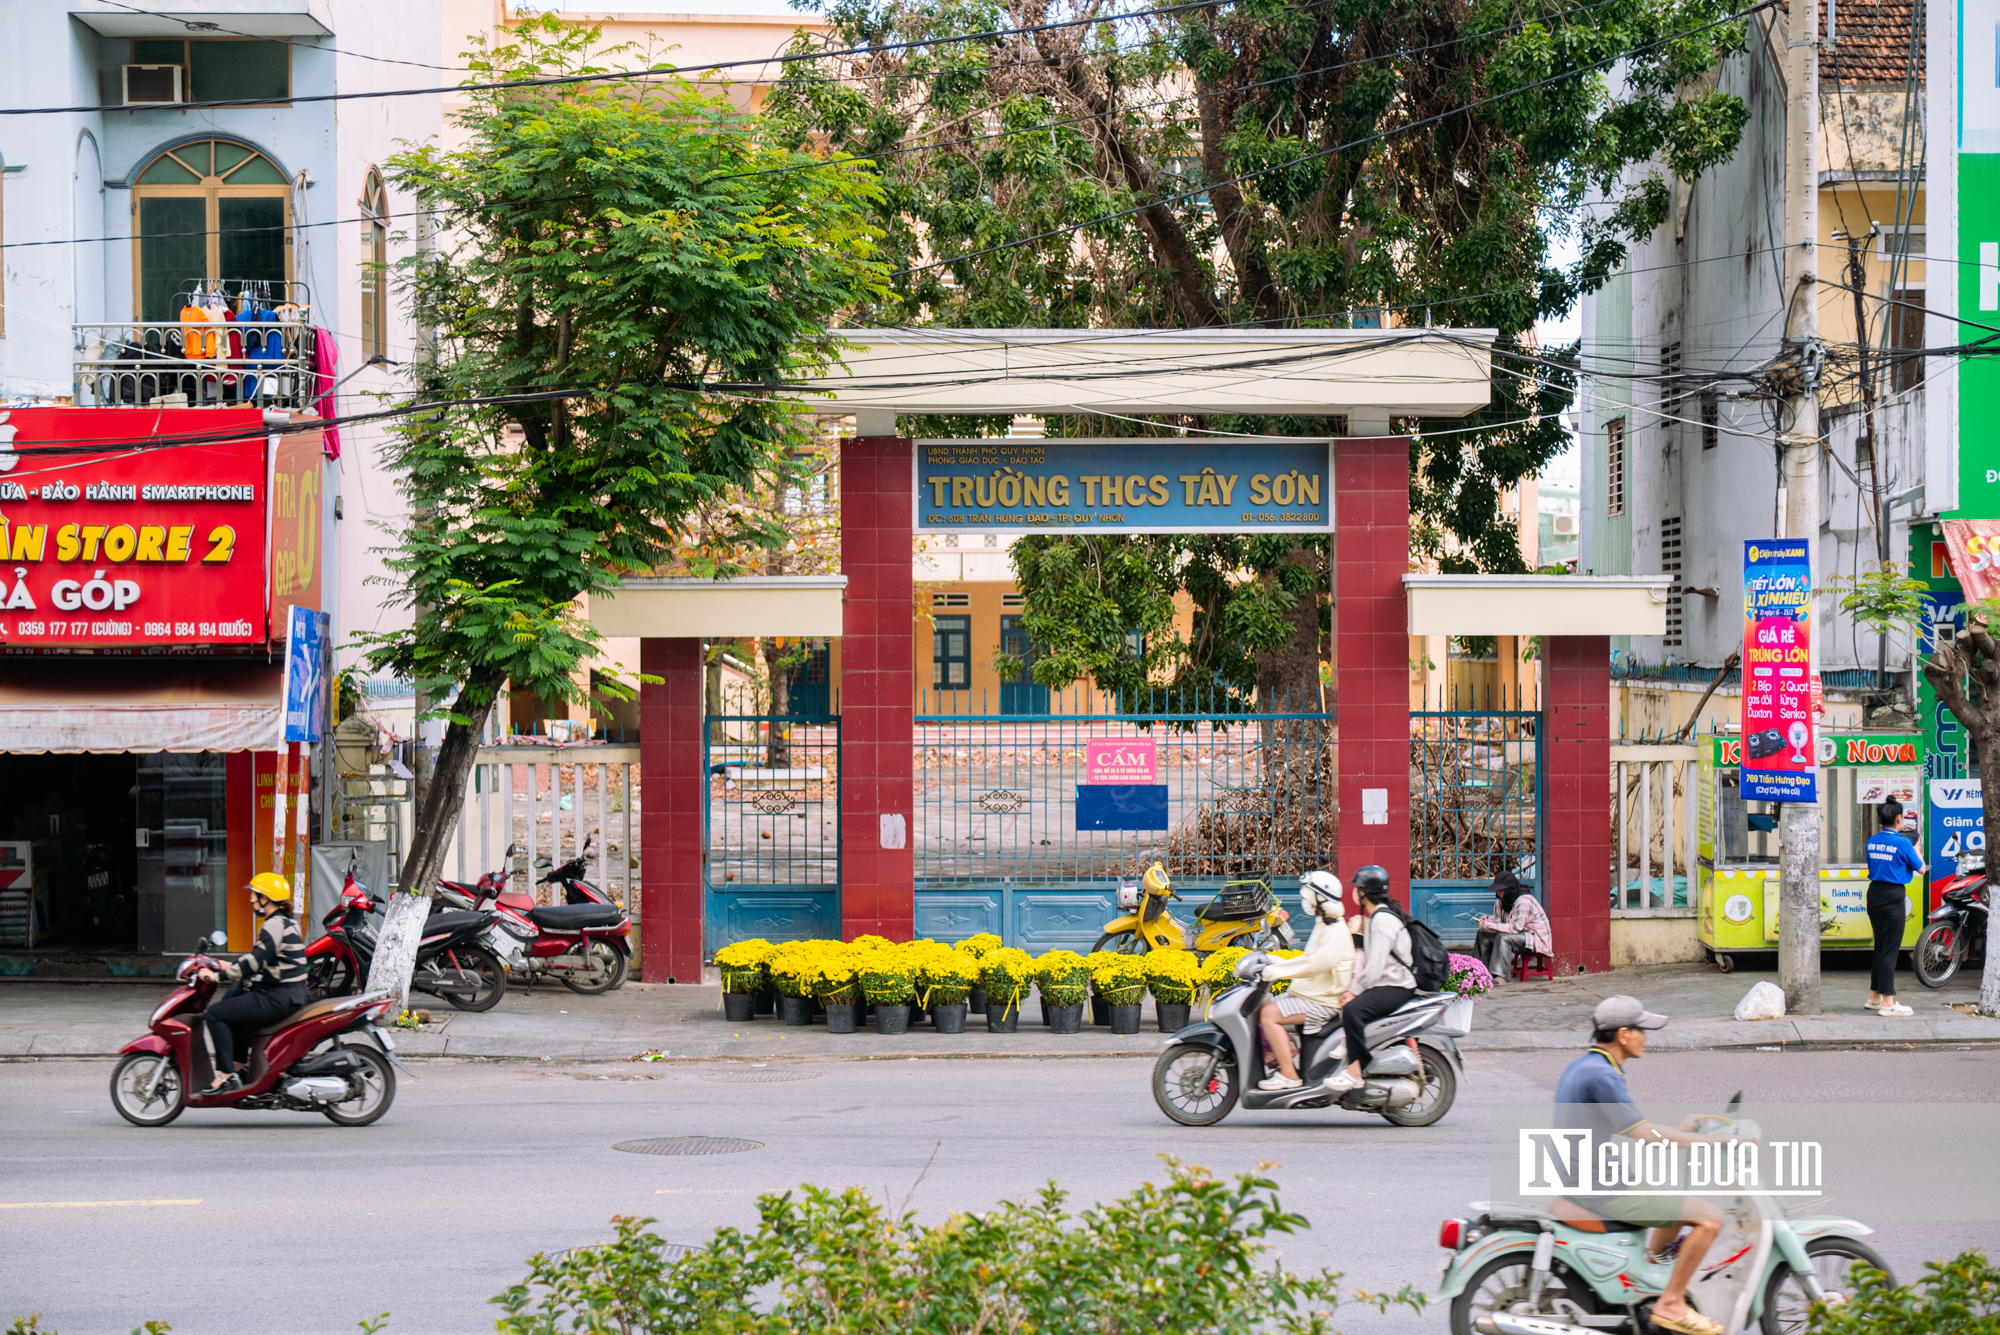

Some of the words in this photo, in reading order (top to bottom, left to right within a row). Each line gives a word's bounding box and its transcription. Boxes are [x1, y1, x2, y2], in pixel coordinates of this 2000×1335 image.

[952, 446, 978, 454] THÀNH
[982, 445, 998, 454] PHỐ
[928, 456, 956, 464] PHÒNG
[958, 456, 979, 464] GIÁO
[982, 457, 999, 466] DỤC
[1010, 456, 1027, 464] ĐÀO
[1030, 457, 1045, 466] TẠO
[41, 480, 81, 500] BẢO
[86, 480, 136, 500] HÀNH
[141, 485, 254, 500] SMARTPHONE
[276, 456, 296, 518] TRẢ
[928, 466, 1070, 507] TRƯỜNG
[1079, 474, 1170, 507] THCS
[1179, 466, 1238, 506] TÂY
[1249, 469, 1320, 506] SƠN
[928, 514, 946, 523] ĐC:
[948, 514, 964, 522] 608
[968, 512, 991, 522] TRẦN
[996, 513, 1023, 523] HƯNG
[1027, 514, 1048, 524] ĐẠO
[1074, 514, 1094, 523] QUY
[1099, 513, 1125, 522] NHƠN
[56, 523, 195, 562] STORE
[201, 525, 236, 562] 2
[276, 538, 296, 596] GÓP
[1752, 574, 1769, 590] TẾT
[1768, 574, 1795, 590] LỚN
[51, 570, 141, 611] GÓP
[1769, 586, 1810, 604] NHIỀU
[18, 622, 45, 635] 0359
[49, 622, 67, 635] 177
[71, 622, 88, 635] 177
[92, 619, 132, 635] (CƯỜNG)
[144, 622, 171, 636] 0964
[175, 622, 195, 636] 584
[198, 622, 216, 636] 194
[219, 619, 252, 636] (QUỐC)
[1758, 626, 1778, 644] GIÁ
[1781, 625, 1794, 643] RẺ
[1749, 645, 1782, 662] TRÚNG
[1785, 645, 1808, 662] LỚN
[1752, 681, 1756, 691] 2
[1758, 679, 1771, 693] Bếp
[1780, 681, 1786, 691] 2
[1786, 681, 1809, 694] Quạt
[1748, 697, 1760, 706] gas
[1761, 694, 1772, 705] đôi
[1748, 708, 1772, 718] Duxton
[1780, 708, 1806, 719] Senko
[1097, 747, 1146, 766] CẤM
[1847, 739, 1917, 764] Nova
[257, 773, 273, 787] LINH
[1746, 774, 1758, 783] 769
[1776, 776, 1795, 786] Hưng
[1796, 776, 1810, 787] Đạo
[1756, 786, 1769, 796] (Chợ
[1943, 816, 1973, 827] Giảm
[1832, 888, 1850, 897] Bánh
[1852, 889, 1863, 900] mỳ
[1836, 904, 1848, 914] thịt
[1849, 904, 1868, 914] nướn
